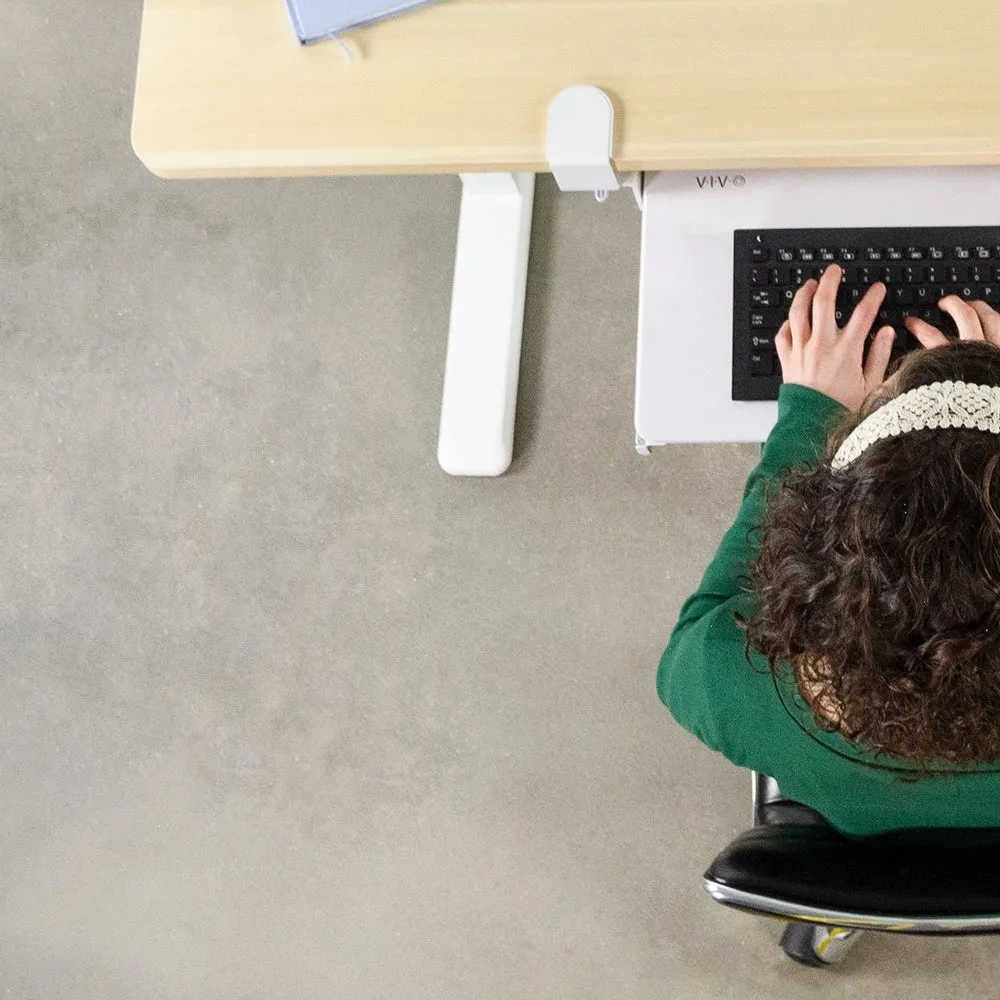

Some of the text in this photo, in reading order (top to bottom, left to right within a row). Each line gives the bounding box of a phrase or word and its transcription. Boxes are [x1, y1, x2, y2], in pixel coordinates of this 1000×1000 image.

[785, 290, 793, 298] Q
[897, 288, 903, 297] Y
[918, 288, 926, 297] U
[963, 287, 971, 296] O
[985, 287, 992, 296] P
